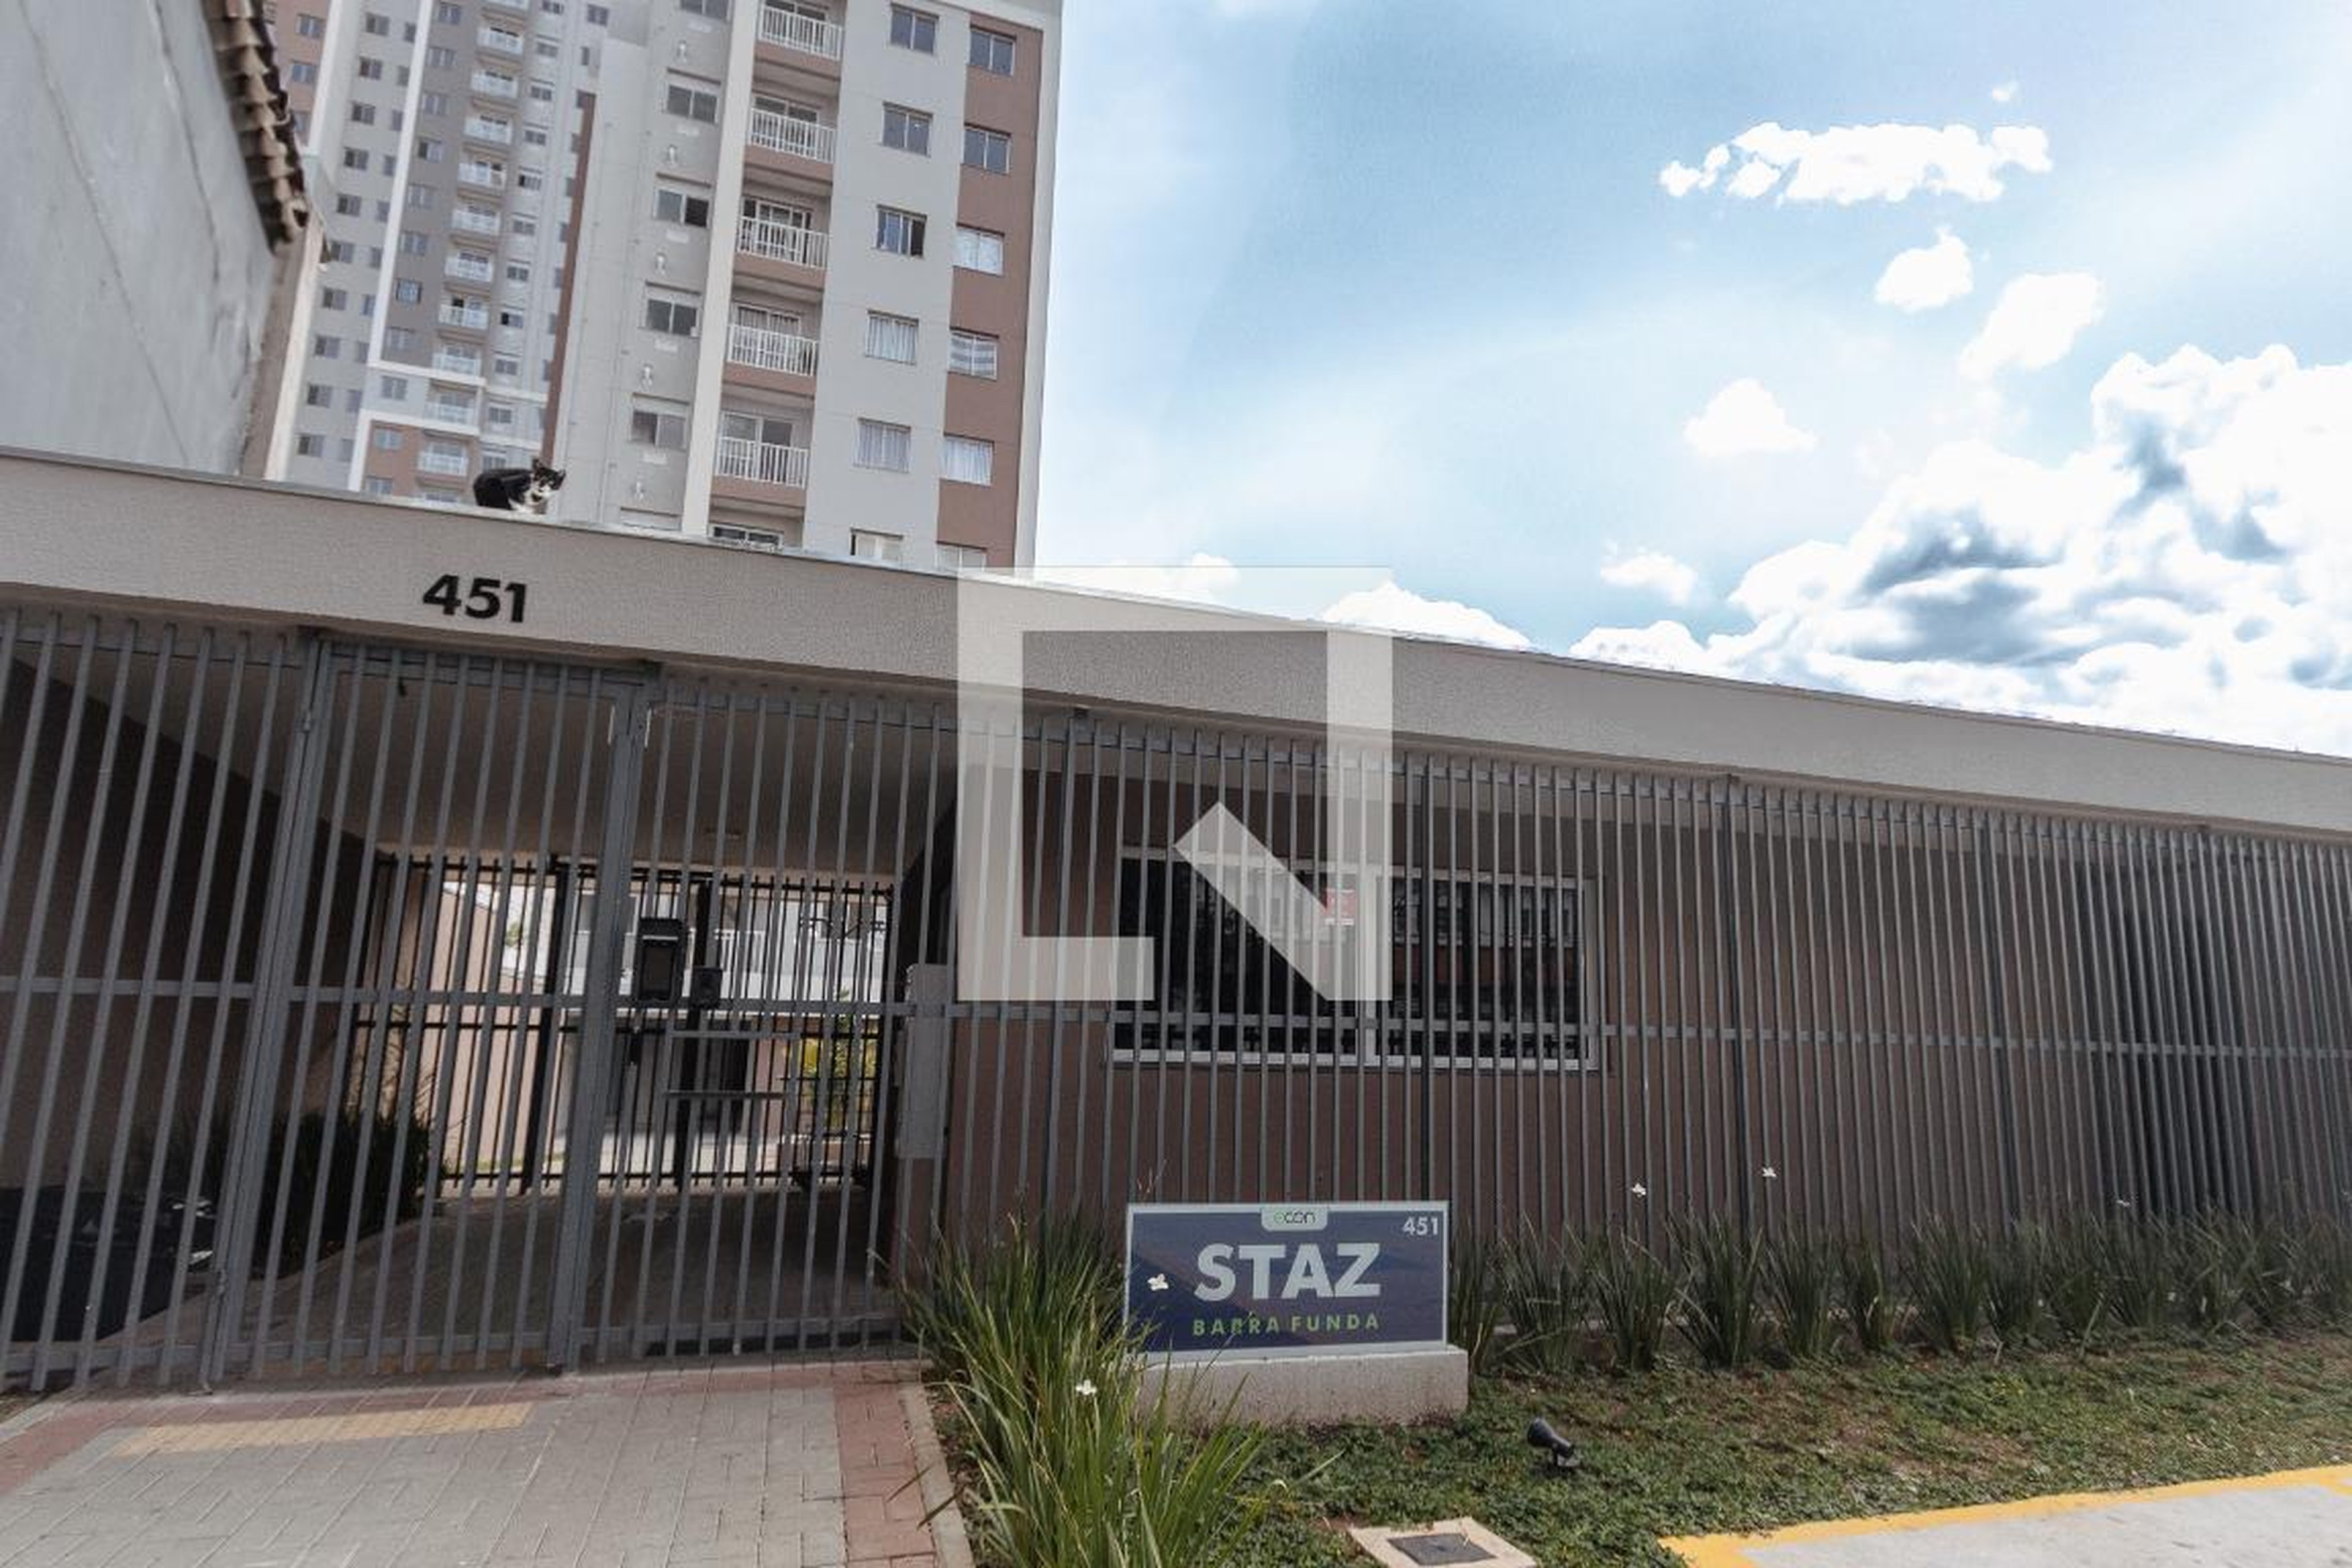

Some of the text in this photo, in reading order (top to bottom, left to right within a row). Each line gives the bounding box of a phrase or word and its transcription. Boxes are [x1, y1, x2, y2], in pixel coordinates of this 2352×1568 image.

[423, 575, 526, 623] 451
[1403, 1216, 1438, 1235] 451
[1194, 1243, 1381, 1301] STAZ
[1193, 1314, 1379, 1336] BARRA FUNDA
